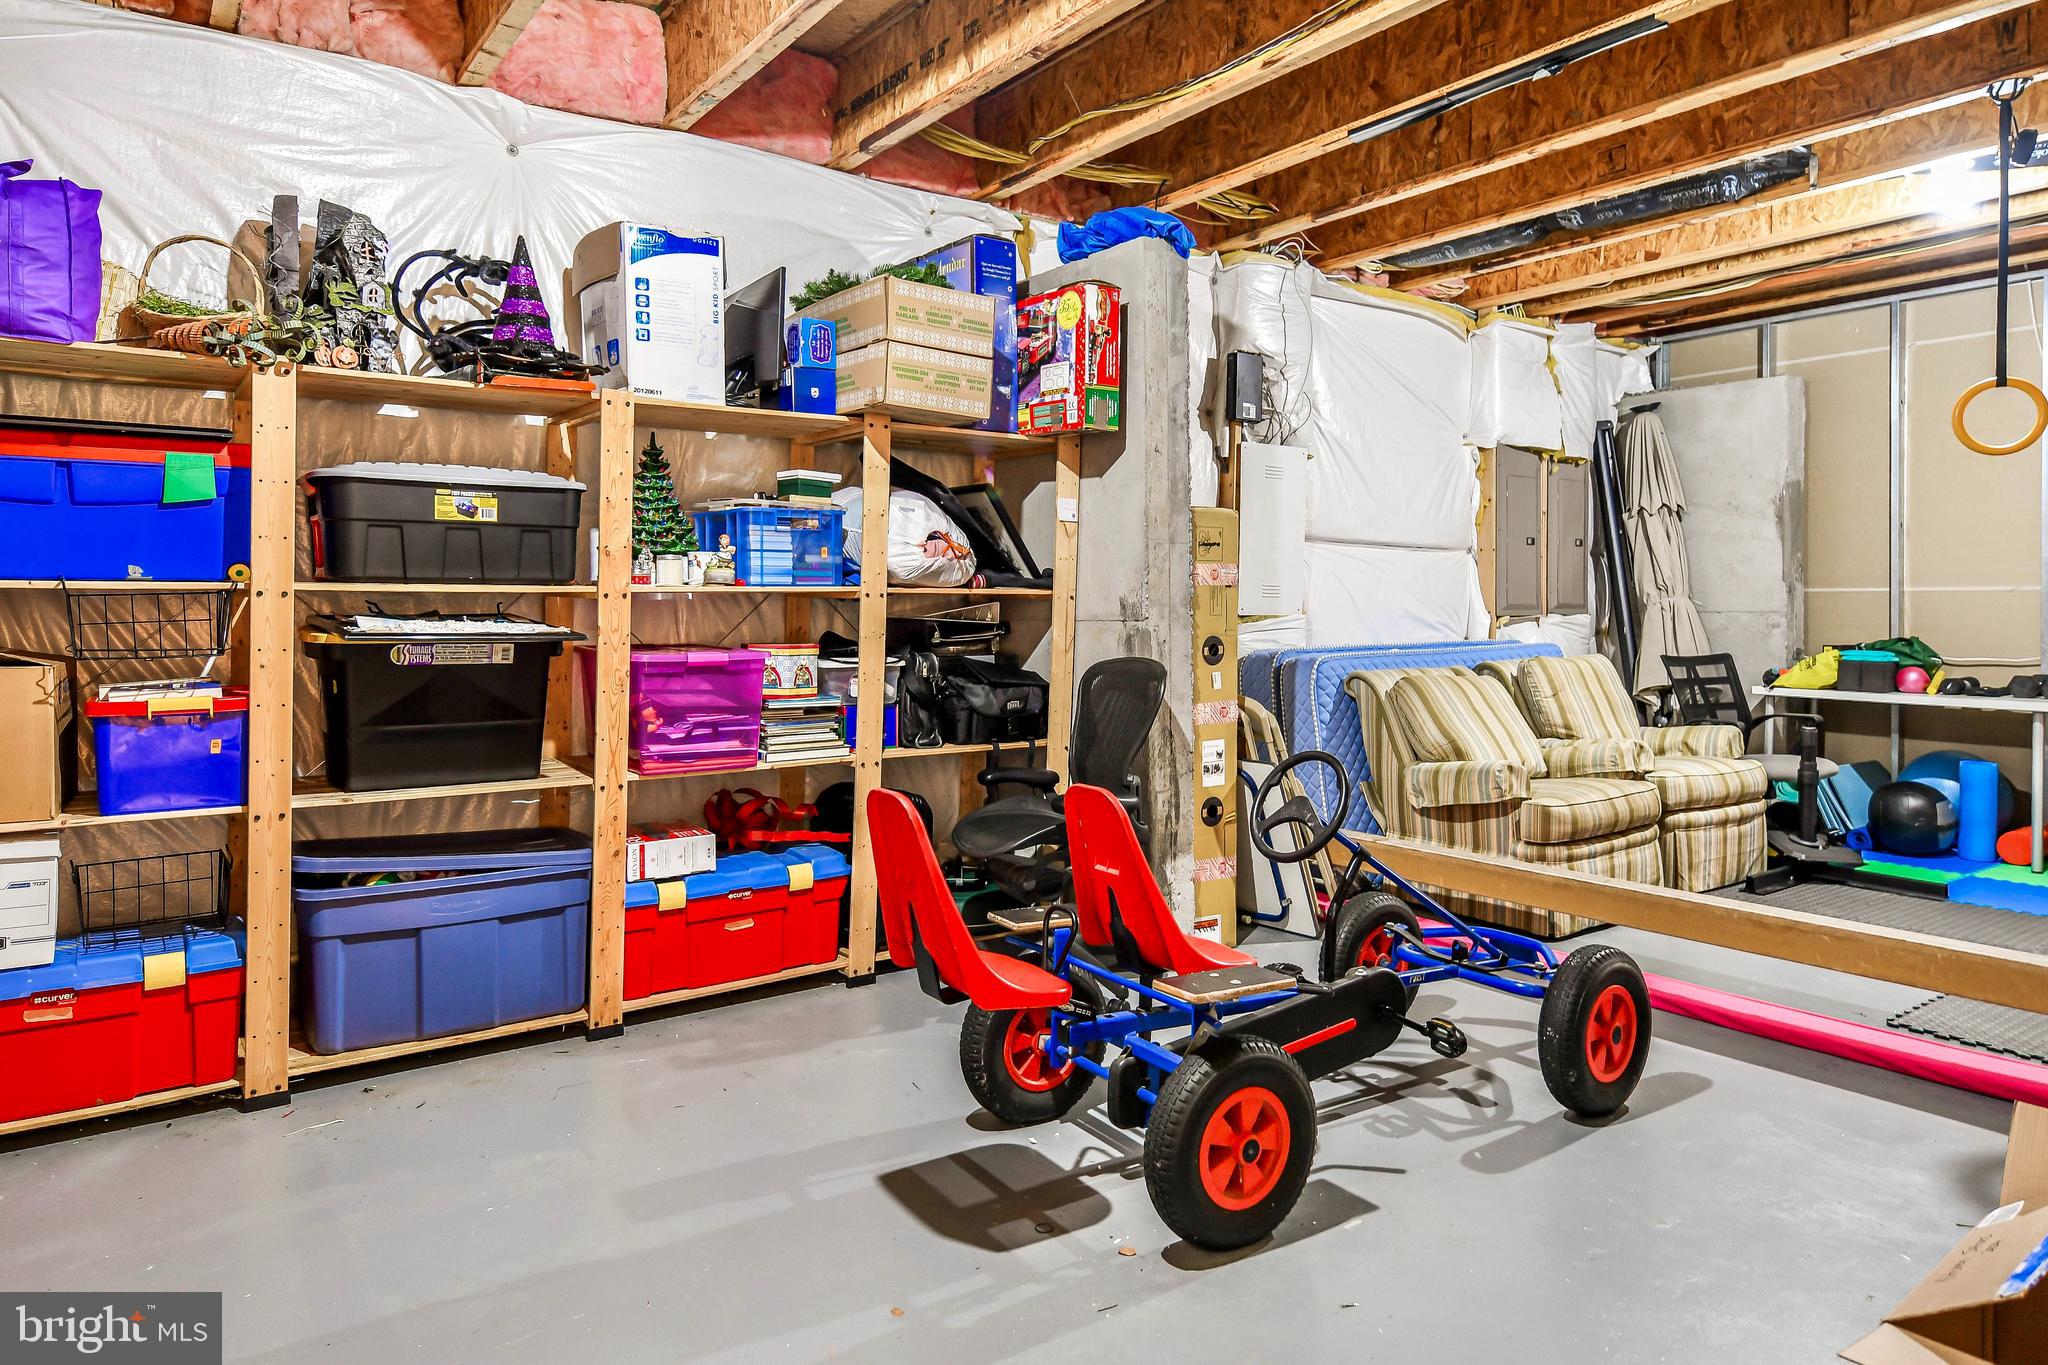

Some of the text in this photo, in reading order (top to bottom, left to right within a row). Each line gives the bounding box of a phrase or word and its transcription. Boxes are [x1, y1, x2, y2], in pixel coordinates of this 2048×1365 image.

[633, 387, 662, 396] 20120611
[733, 890, 752, 899] curver
[42, 993, 75, 1003] curver
